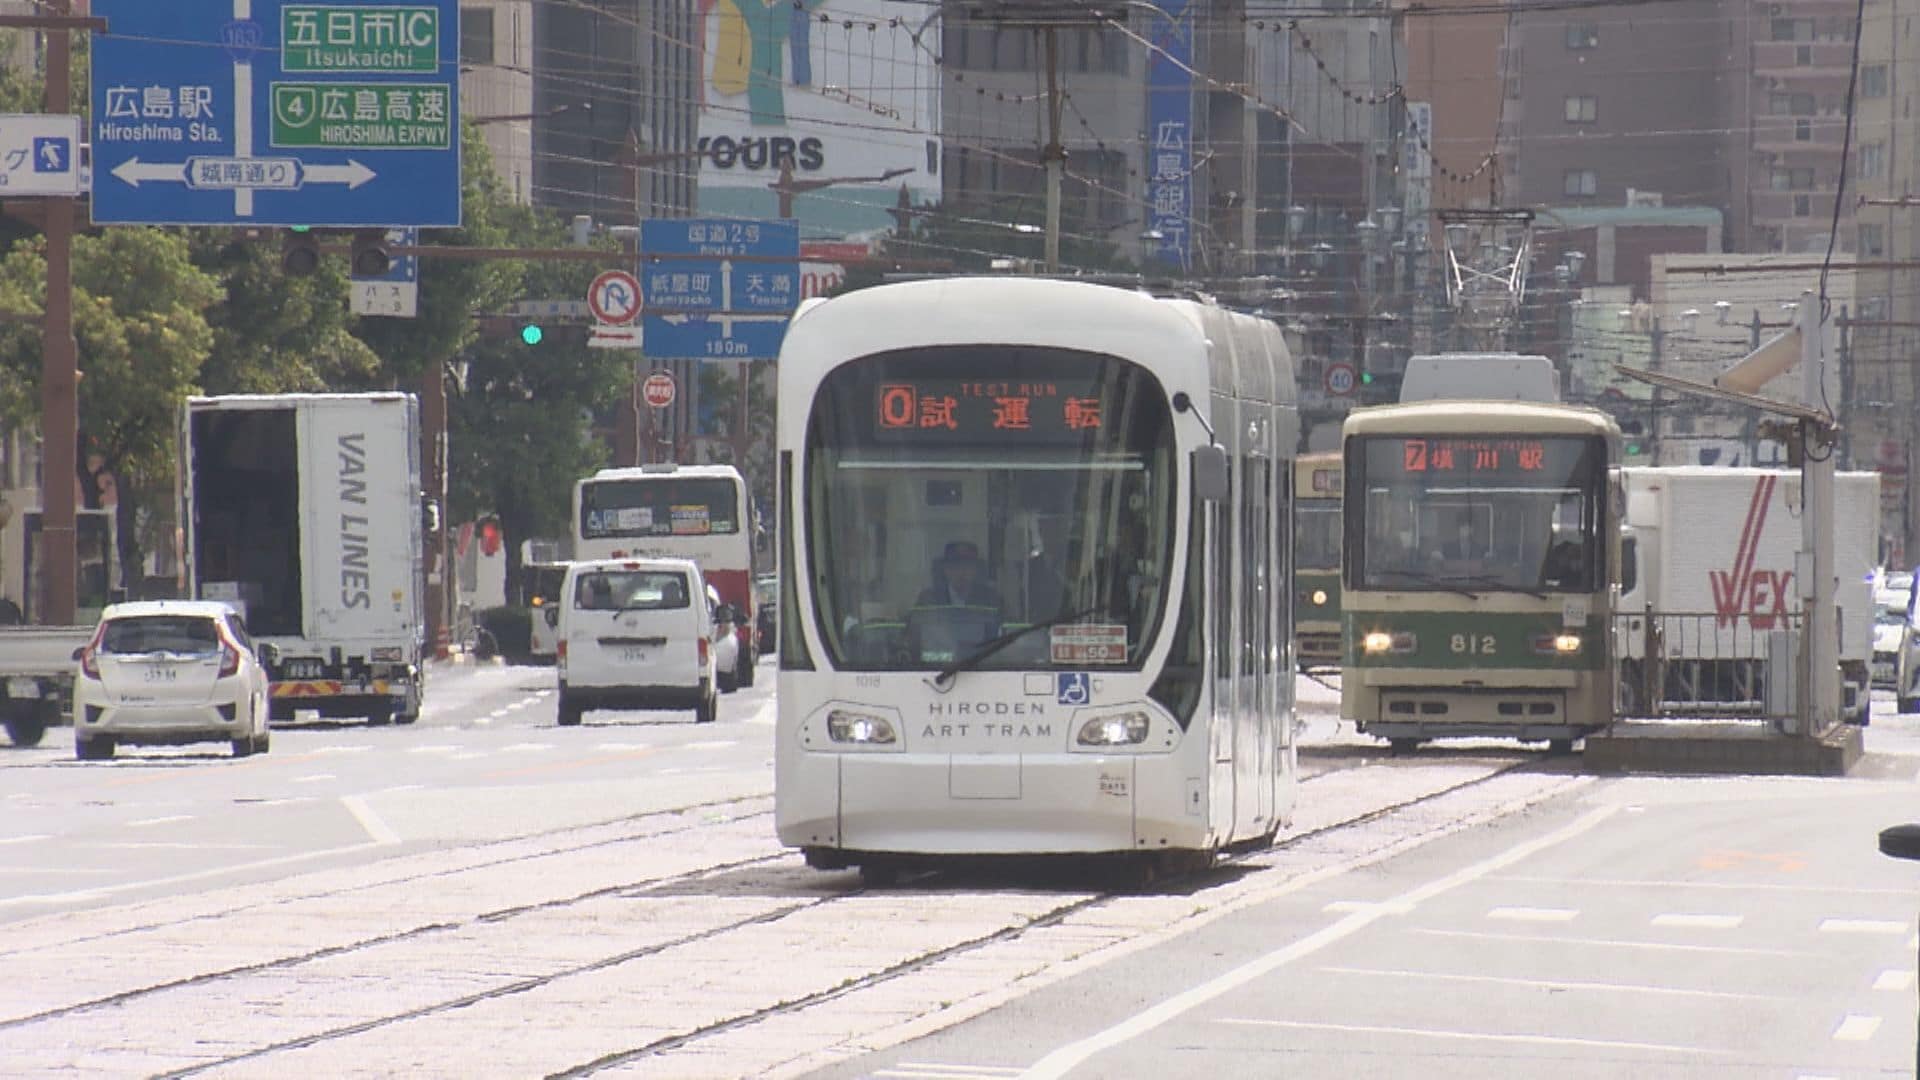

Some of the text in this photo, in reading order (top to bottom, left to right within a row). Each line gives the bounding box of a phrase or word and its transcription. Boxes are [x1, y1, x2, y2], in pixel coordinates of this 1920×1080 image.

[306, 48, 412, 66] Itsukaichi
[105, 84, 214, 118] 広島駅
[288, 96, 304, 116] 4
[320, 88, 444, 122] 広島高速
[99, 121, 222, 142] Hiroshima Sta.
[320, 125, 446, 144] HIROSHIMA EXPWY
[200, 162, 286, 184] 城南通り
[961, 383, 1057, 396] TEST RUN
[919, 395, 1102, 430] 試運転
[338, 433, 370, 610] VAN LINES
[1451, 634, 1497, 654] 812
[929, 702, 1046, 715] HIRODEN
[922, 723, 1052, 737] ART TRAM
